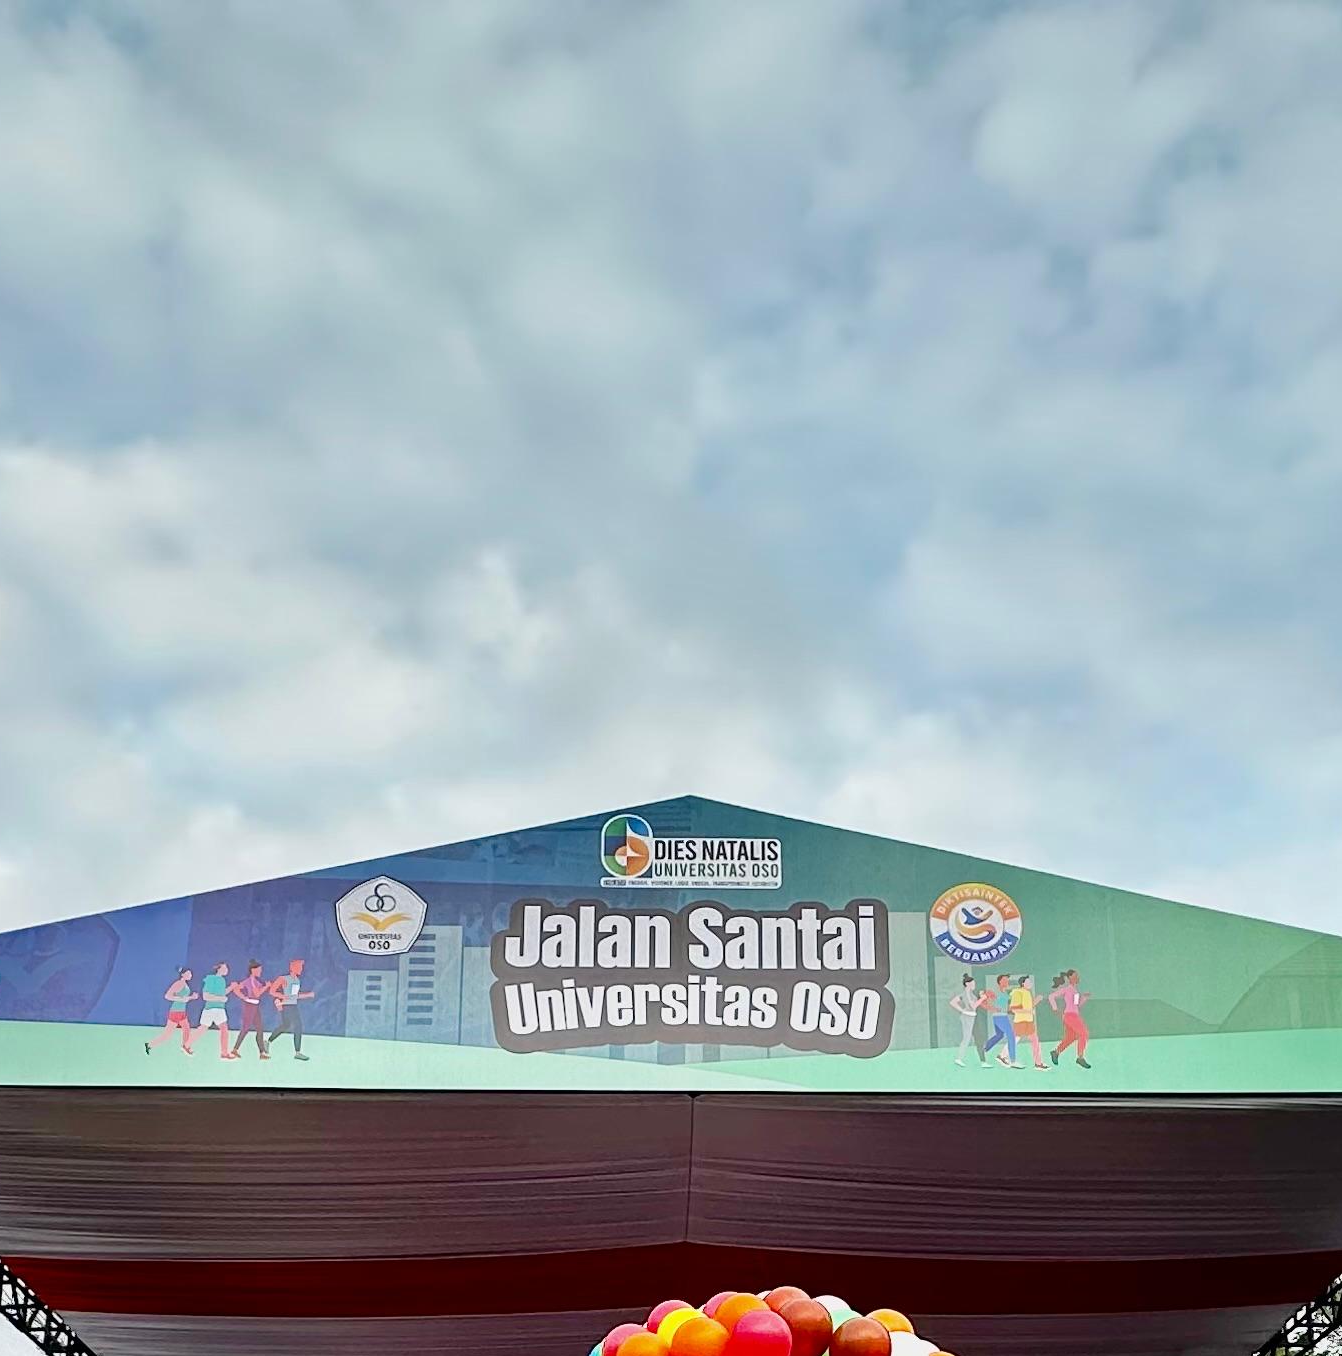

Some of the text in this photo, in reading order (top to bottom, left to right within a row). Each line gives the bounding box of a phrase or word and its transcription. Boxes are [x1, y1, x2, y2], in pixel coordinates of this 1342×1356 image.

[654, 840, 779, 861] DIES NATALIS
[654, 863, 779, 878] UNIVERSITAS OSO
[368, 940, 391, 950] OSO
[504, 905, 876, 971] Jalan Santai
[939, 937, 1014, 962] BERDAMPAK
[504, 974, 882, 1040] Universitas OSO
